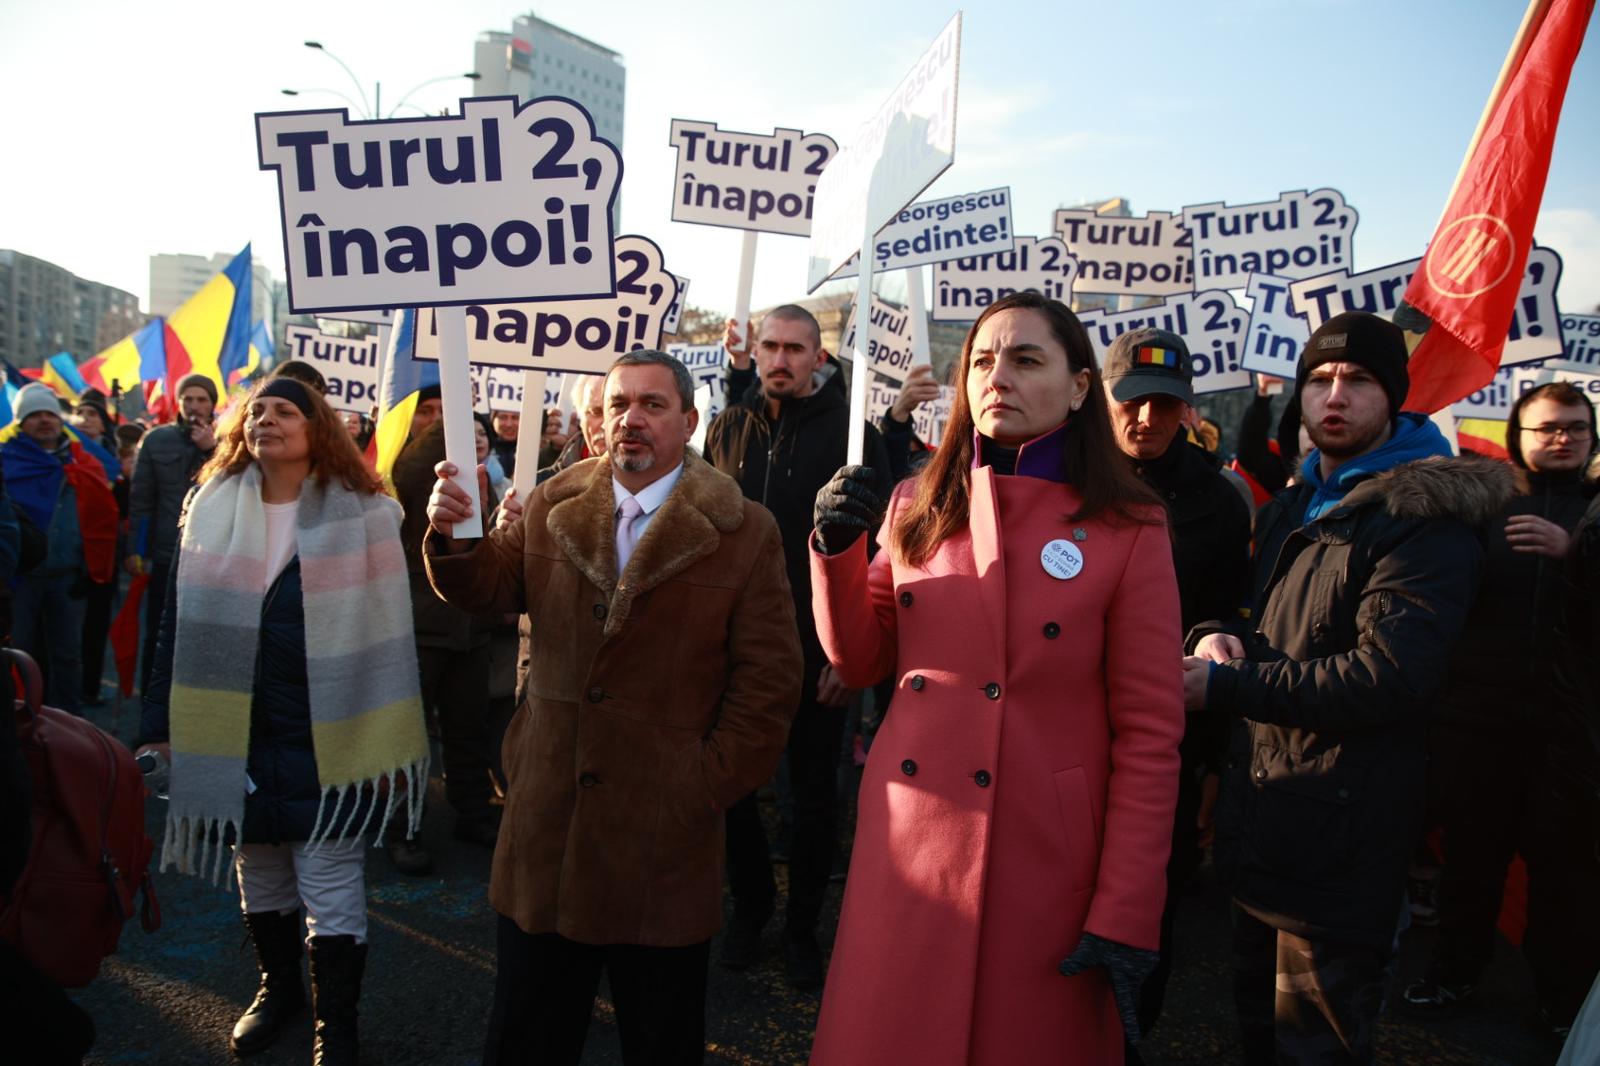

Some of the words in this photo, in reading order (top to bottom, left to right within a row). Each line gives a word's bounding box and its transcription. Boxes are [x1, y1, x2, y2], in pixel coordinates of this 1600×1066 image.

[277, 117, 502, 193] Turul
[527, 117, 603, 191] 2,
[680, 130, 792, 172] Turul
[804, 143, 829, 176] 2
[682, 172, 816, 221] înapoi
[1064, 218, 1162, 247] Turul
[1173, 222, 1193, 248] 2
[1193, 200, 1299, 239] Turul
[1313, 197, 1348, 229] 2,
[296, 197, 593, 287] înapoi!
[876, 217, 1008, 268] ședinte!
[1041, 246, 1070, 276] 2,
[1202, 234, 1343, 276] înapoi!
[617, 250, 663, 305] 2,
[1070, 253, 1193, 288] napoi!
[1201, 299, 1240, 334] 2,
[1304, 275, 1412, 324] Tur
[870, 306, 908, 337] urul
[294, 333, 378, 368] Turul
[671, 345, 725, 366] Turul
[847, 325, 913, 371] îapoi!
[871, 387, 899, 406] Tur
[1043, 553, 1054, 564] CU
[1060, 550, 1080, 567] POT
